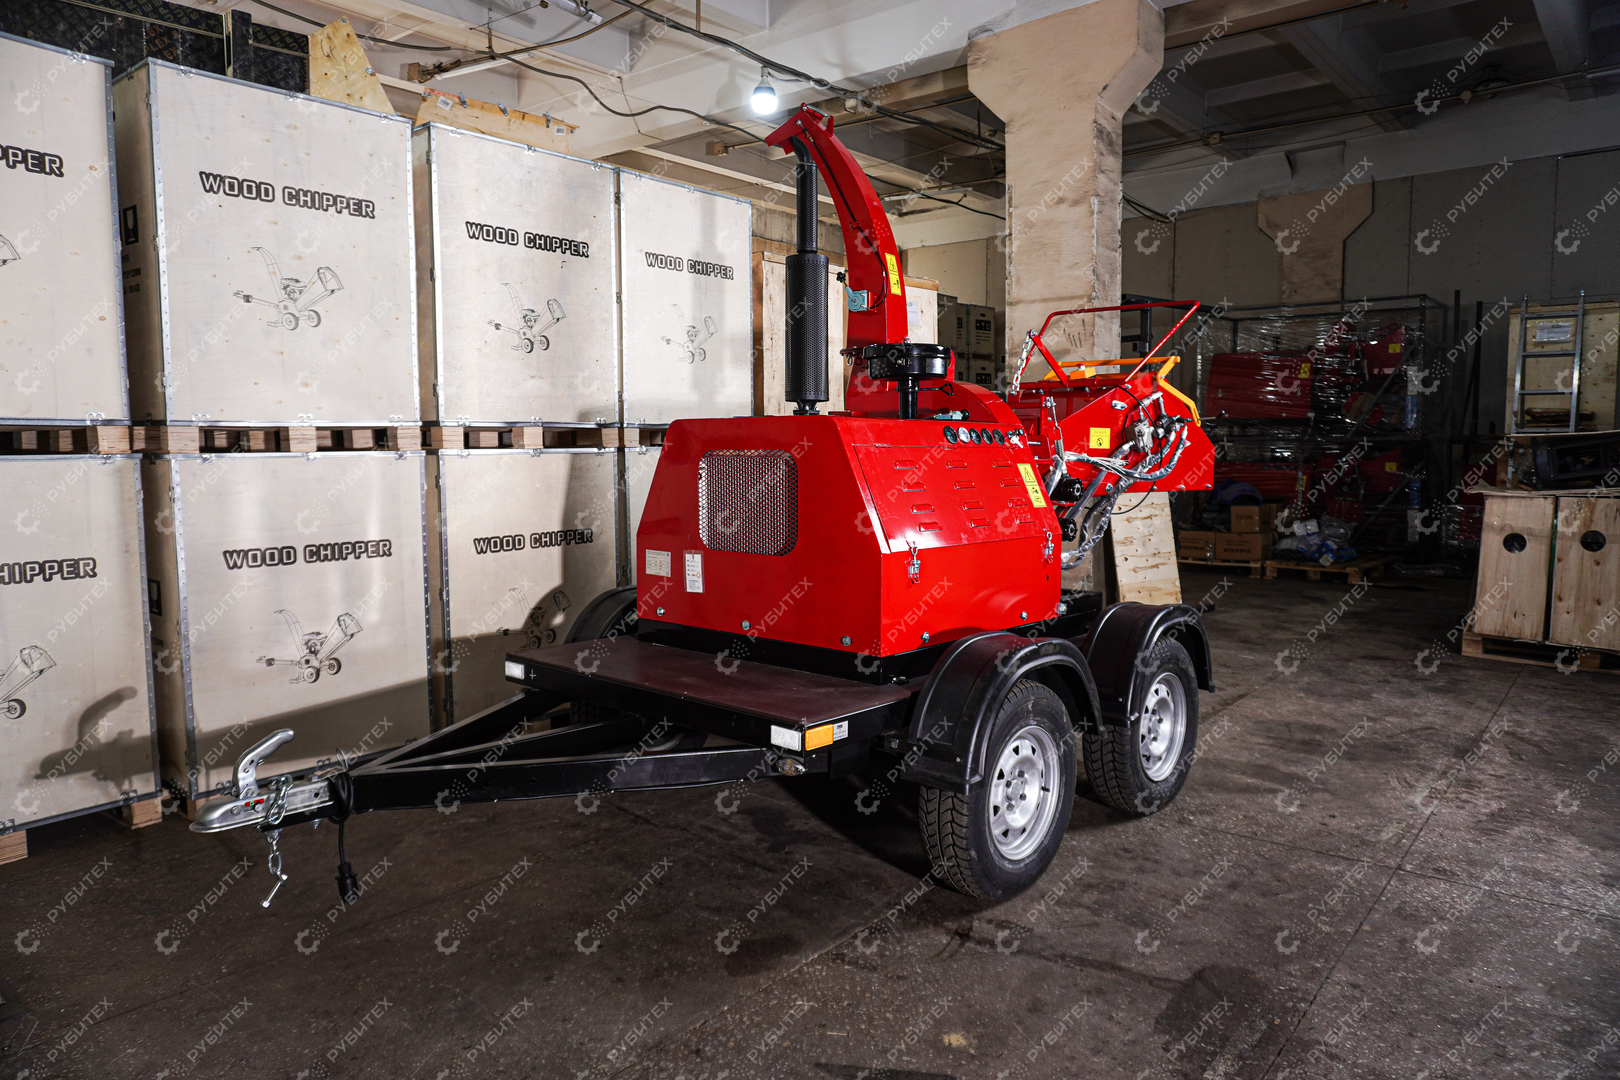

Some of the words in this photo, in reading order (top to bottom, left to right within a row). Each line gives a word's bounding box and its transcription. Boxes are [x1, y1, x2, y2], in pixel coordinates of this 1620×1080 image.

[199, 171, 276, 203] WOOD
[282, 185, 376, 219] CHIPPER
[465, 221, 519, 246] WOOD
[524, 231, 590, 258] CHIPPER
[645, 251, 684, 272] WOOD
[687, 258, 735, 280] CHIPPER
[222, 545, 297, 570] WOOD
[303, 539, 393, 564] CHIPPER
[473, 534, 526, 555] WOOD
[530, 527, 594, 549] CHIPPER
